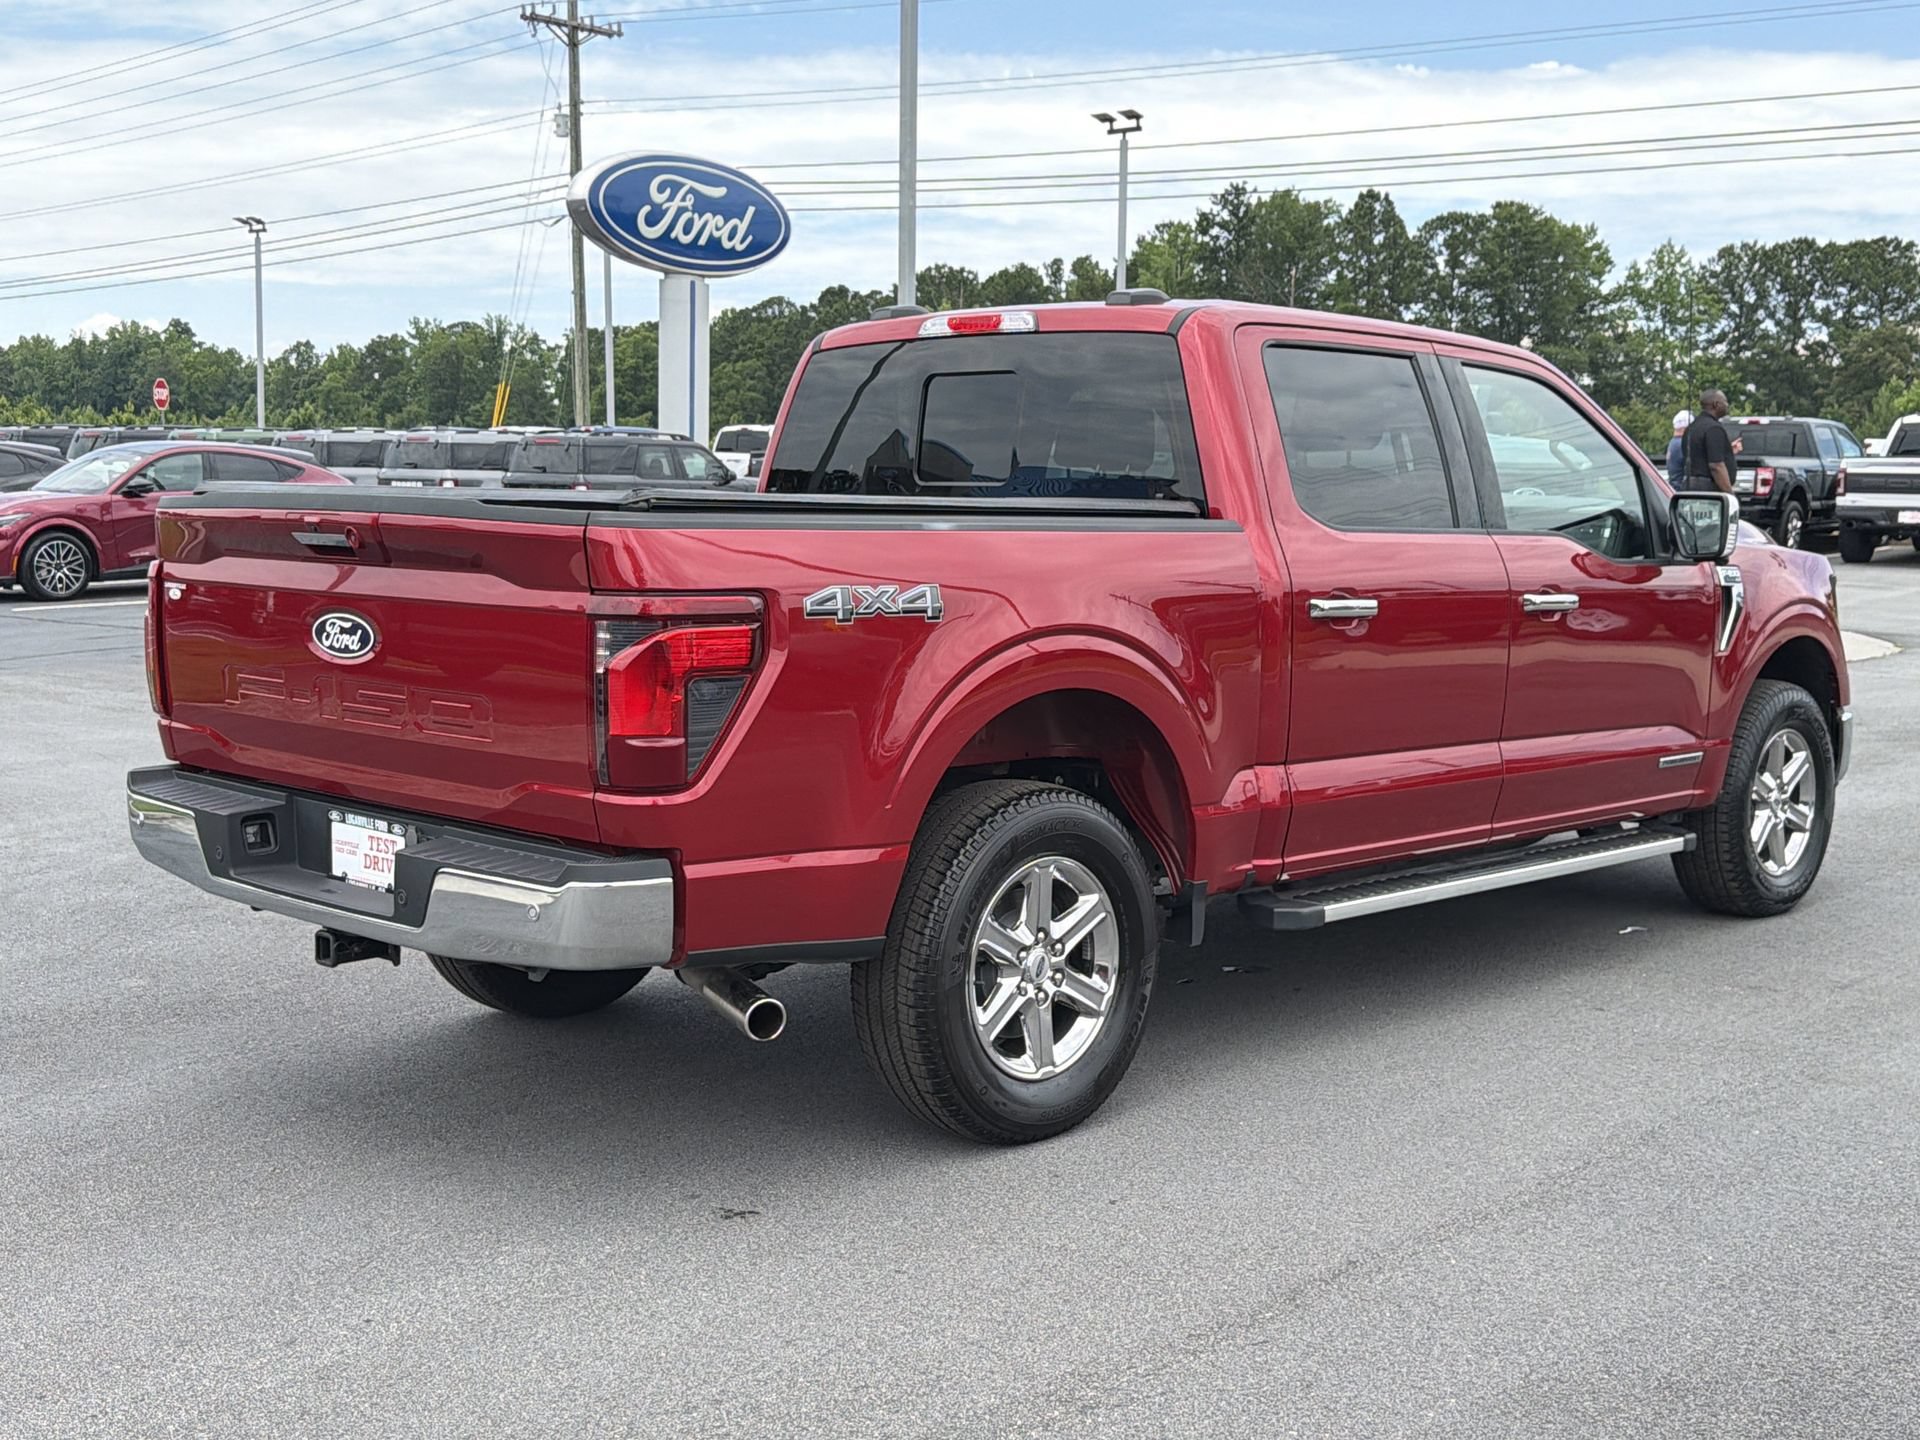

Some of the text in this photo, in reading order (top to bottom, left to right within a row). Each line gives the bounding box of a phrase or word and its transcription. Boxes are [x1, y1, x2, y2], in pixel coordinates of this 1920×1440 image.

[637, 173, 756, 252] Ford
[321, 618, 363, 651] Ford
[223, 664, 493, 743] F-150
[368, 835, 397, 855] TEST
[364, 853, 393, 874] DRIV
